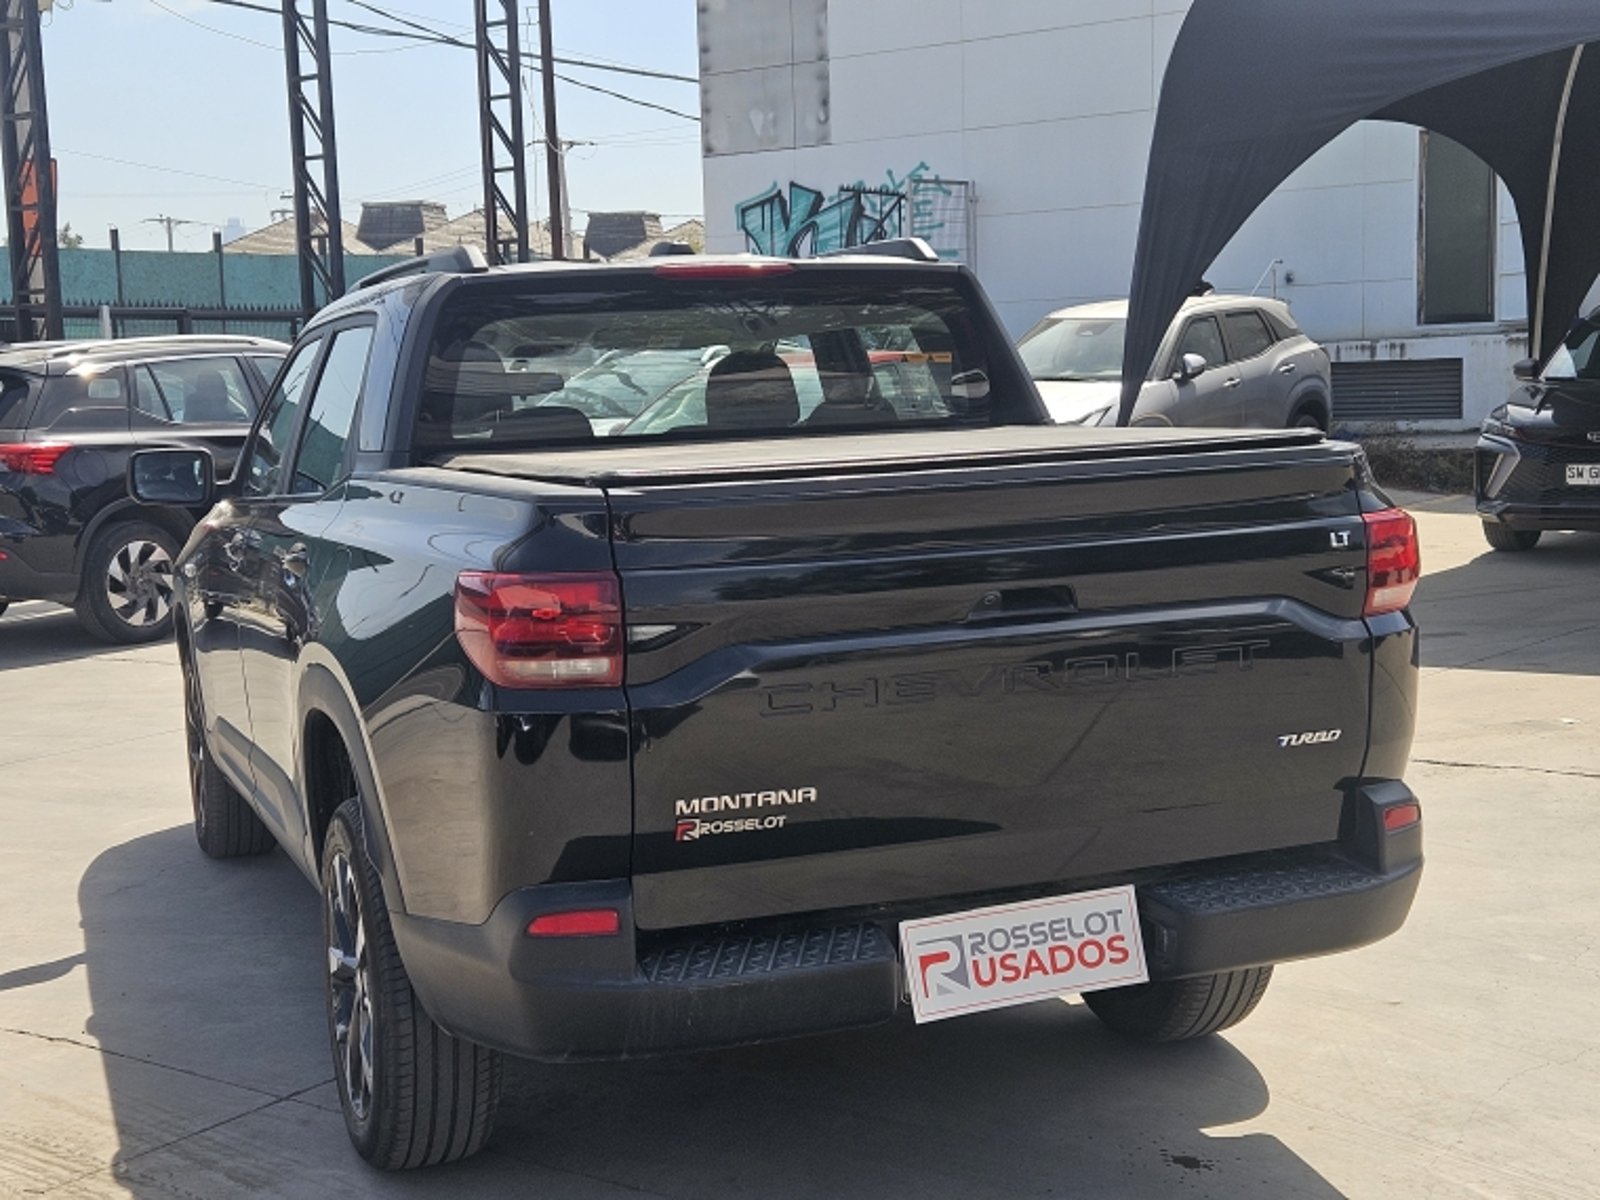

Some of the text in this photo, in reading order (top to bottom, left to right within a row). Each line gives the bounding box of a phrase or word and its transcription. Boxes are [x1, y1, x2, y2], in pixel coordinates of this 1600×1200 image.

[1568, 467, 1584, 478] SW
[1329, 531, 1350, 547] LT
[759, 638, 1270, 717] CHEVROLET
[1278, 729, 1342, 747] TURBO
[675, 787, 817, 815] MONTANA
[700, 815, 787, 835] ROSSELOT
[968, 909, 1123, 956] ROSSELOT
[972, 935, 1130, 987] USADOS
